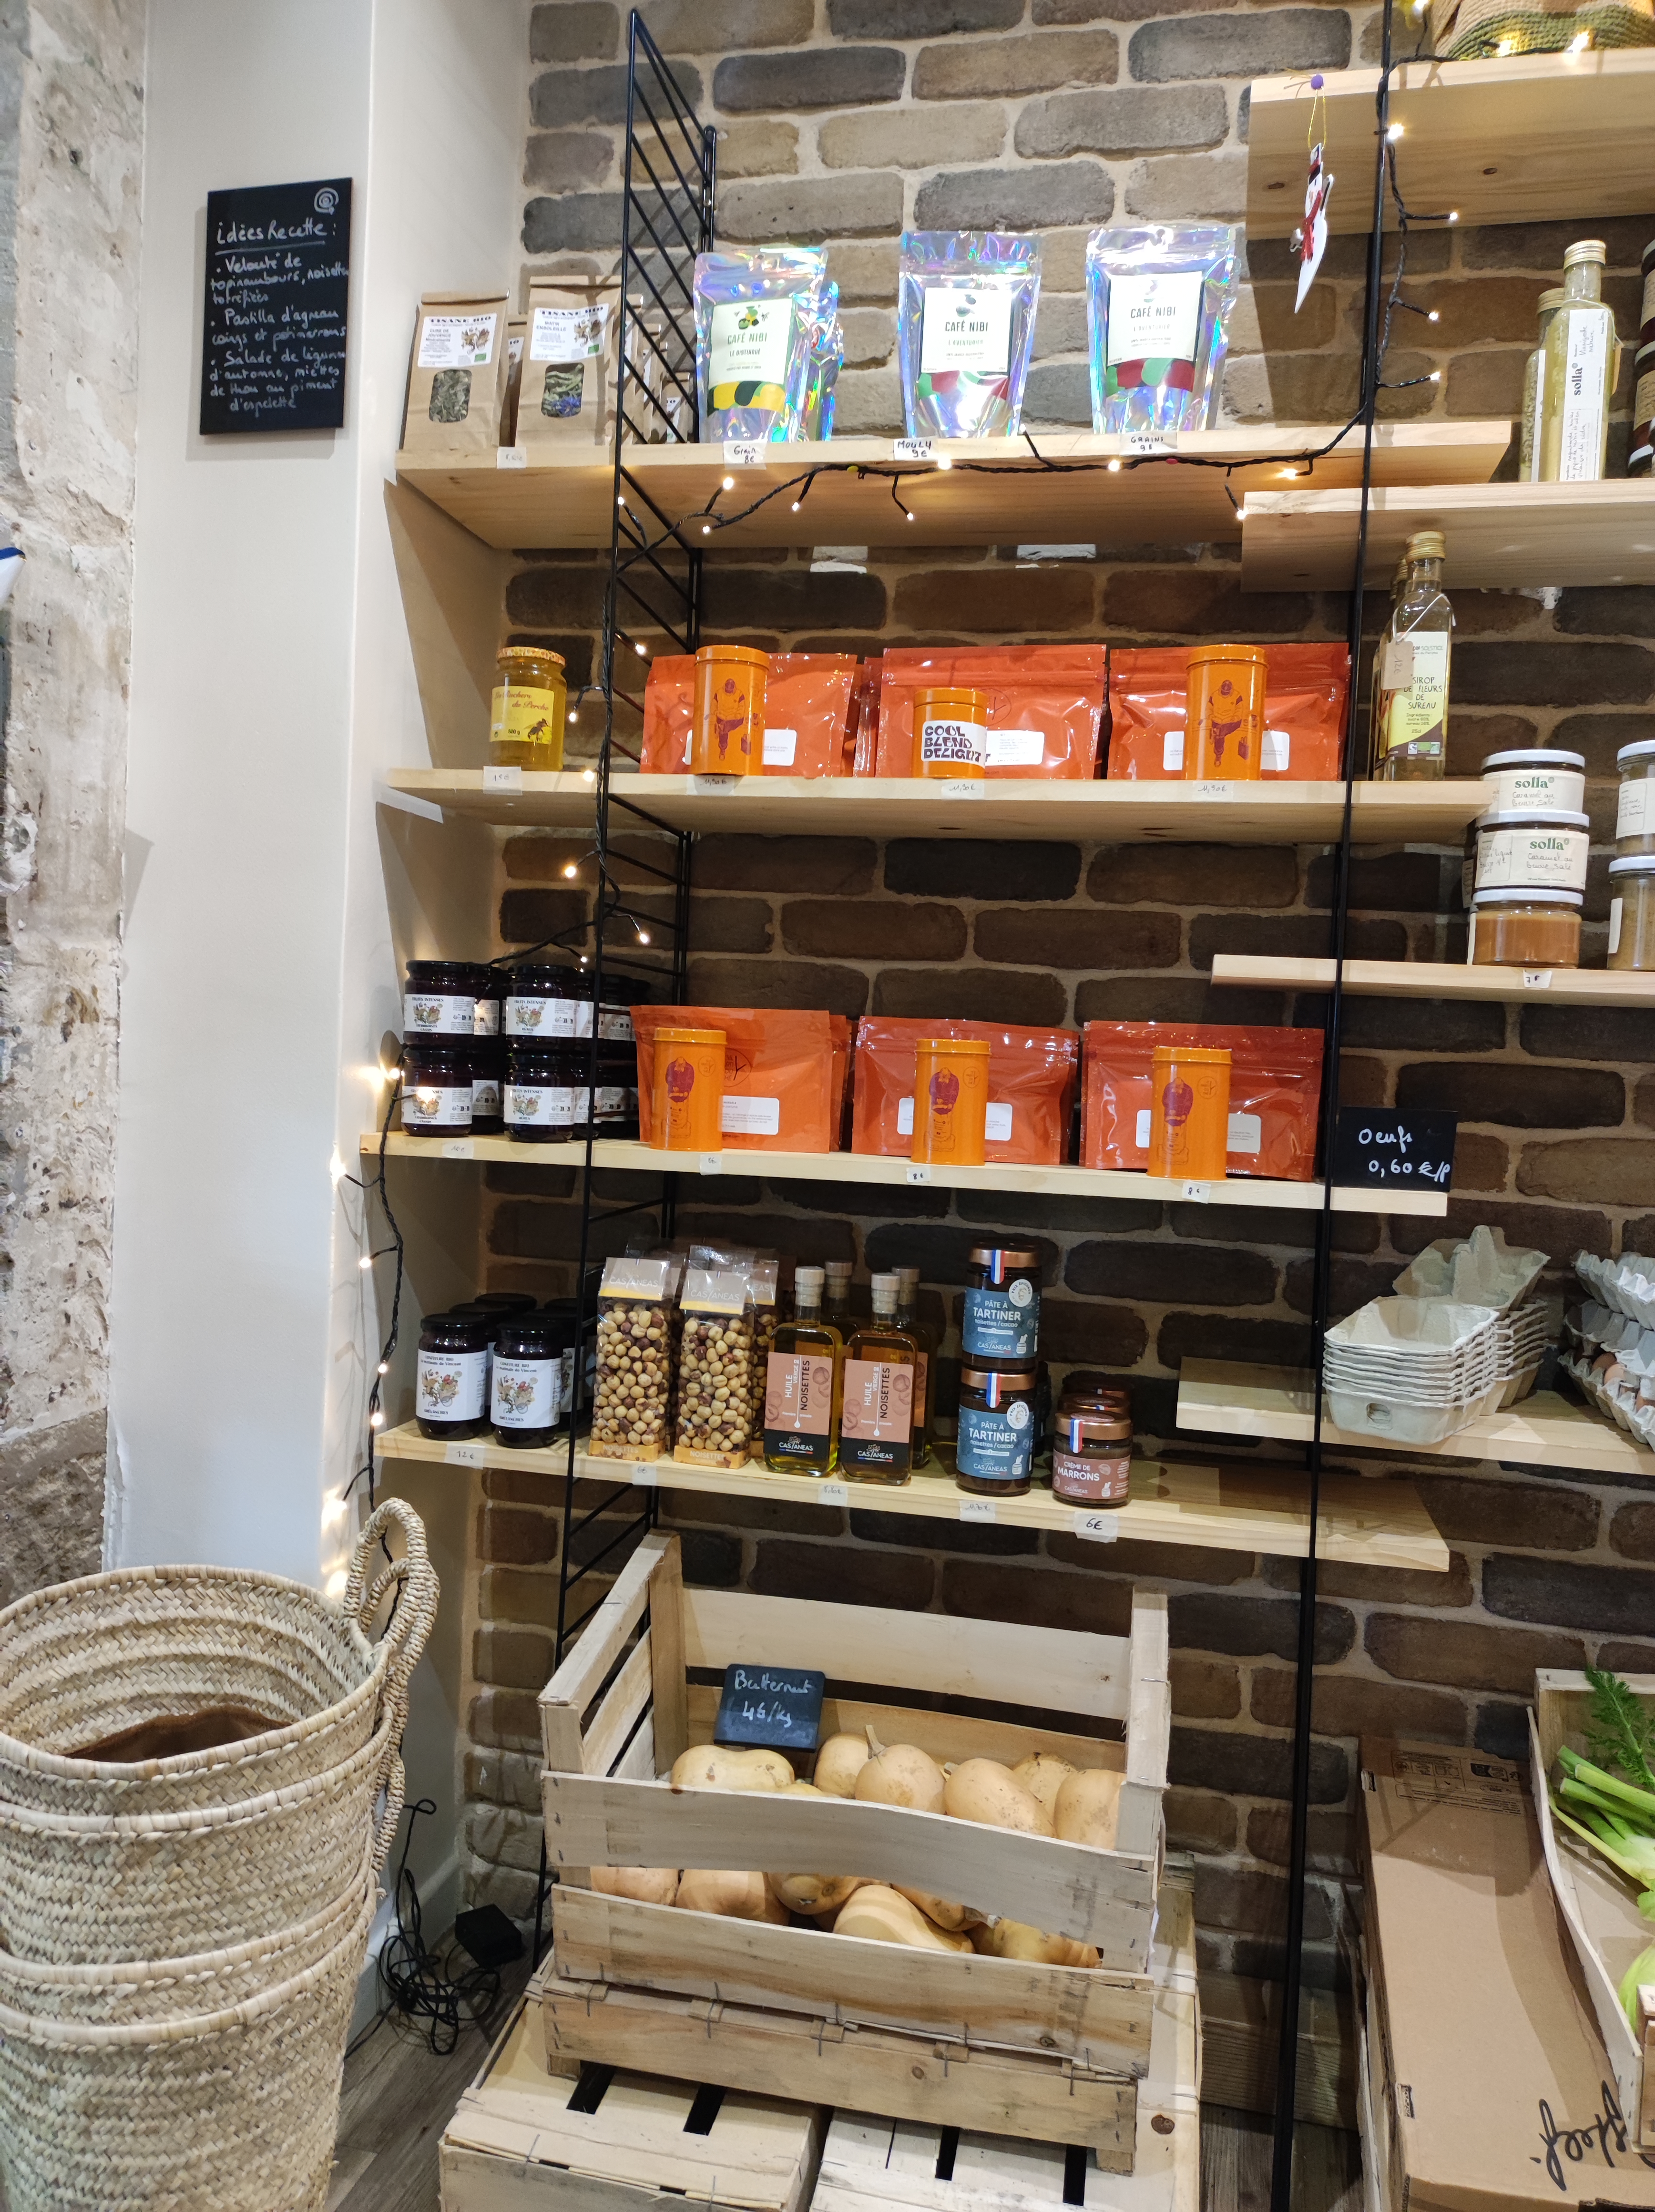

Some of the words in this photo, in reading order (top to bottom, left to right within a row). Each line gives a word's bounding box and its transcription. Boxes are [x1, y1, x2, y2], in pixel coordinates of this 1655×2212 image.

[225, 252, 280, 273] Velouté
[285, 252, 302, 268] de
[224, 308, 275, 326] Pastilla
[281, 304, 339, 329] d'agneau
[1130, 306, 1152, 319] CAFÉ
[1156, 306, 1176, 317] NIBI
[945, 319, 966, 332] CAFÉ
[969, 321, 988, 332] NIBI
[212, 332, 248, 352] coings
[254, 328, 268, 341] et
[727, 332, 746, 345] CAFÉ
[749, 332, 767, 343] NIBI
[224, 348, 272, 368] Salade
[280, 348, 299, 363] de
[294, 364, 340, 378] miettes
[1573, 367, 1583, 396] solla
[210, 384, 226, 397] de
[266, 384, 285, 393] au
[290, 378, 338, 399] piment
[734, 445, 756, 455] Grain
[924, 725, 965, 737] COOL
[924, 737, 972, 749] BLEND
[1514, 777, 1549, 789] solla
[1530, 838, 1564, 850] solla
[1527, 852, 1560, 861] Caramel
[1359, 1126, 1413, 1153] Oeufs
[1369, 1159, 1412, 1178] 0,60
[609, 1277, 658, 1289] CASTANEAS
[690, 1290, 740, 1301] CASTANEAS
[985, 1300, 1001, 1308] PÂTE
[1002, 1301, 1008, 1309] À
[973, 1307, 1021, 1321] TARTINER
[978, 1342, 1011, 1351] CASTANEAS
[785, 1374, 793, 1398] HUILE
[800, 1360, 810, 1411] NOISETTES
[864, 1382, 872, 1406] HUILE
[880, 1367, 890, 1419] NOISETTES
[981, 1421, 997, 1430] PÂTE
[999, 1422, 1004, 1430] À
[969, 1427, 1017, 1442] TARTINER
[603, 1444, 638, 1454] NOISETTES
[779, 1442, 813, 1451] CASTANEAS
[970, 1439, 993, 1448] noisettes
[690, 1450, 725, 1460] NOISETTES
[857, 1450, 893, 1459] CASTANEAS
[973, 1463, 1008, 1472] CASTANEAS
[1064, 1460, 1082, 1470] CRÈME
[1058, 1466, 1100, 1481] MARRONS
[1064, 1485, 1088, 1494] CASTANEAS
[1086, 1518, 1103, 1530] 6€
[735, 1669, 816, 1694] Butternut
